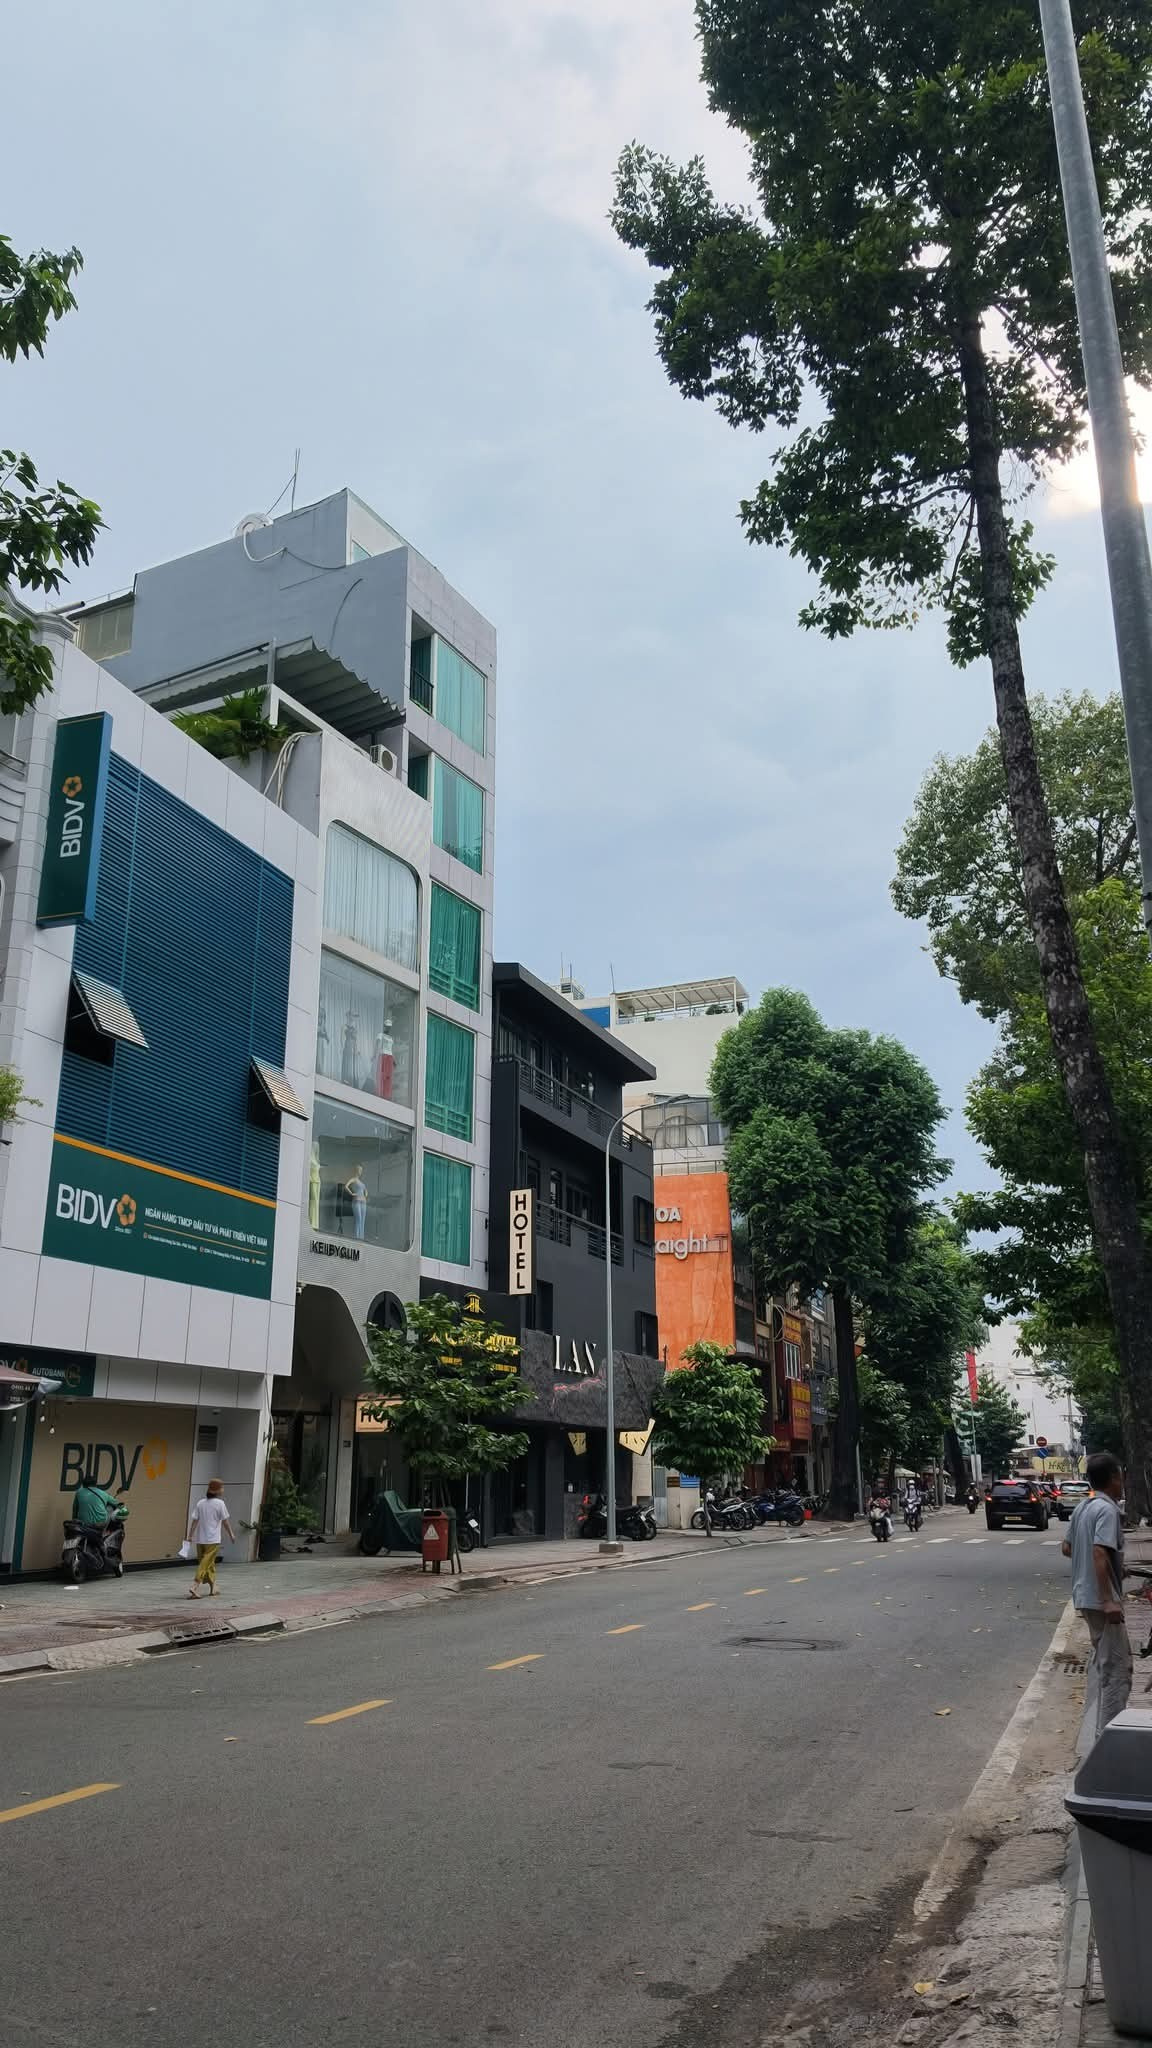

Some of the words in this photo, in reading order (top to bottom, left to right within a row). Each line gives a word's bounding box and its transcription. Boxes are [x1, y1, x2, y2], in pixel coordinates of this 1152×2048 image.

[60, 797, 85, 858] BIDV
[56, 1183, 118, 1229] BIDV
[655, 1207, 682, 1223] OA
[513, 1193, 528, 1290] HOTEL
[655, 1226, 709, 1260] aight
[60, 1443, 144, 1492] BIDV
